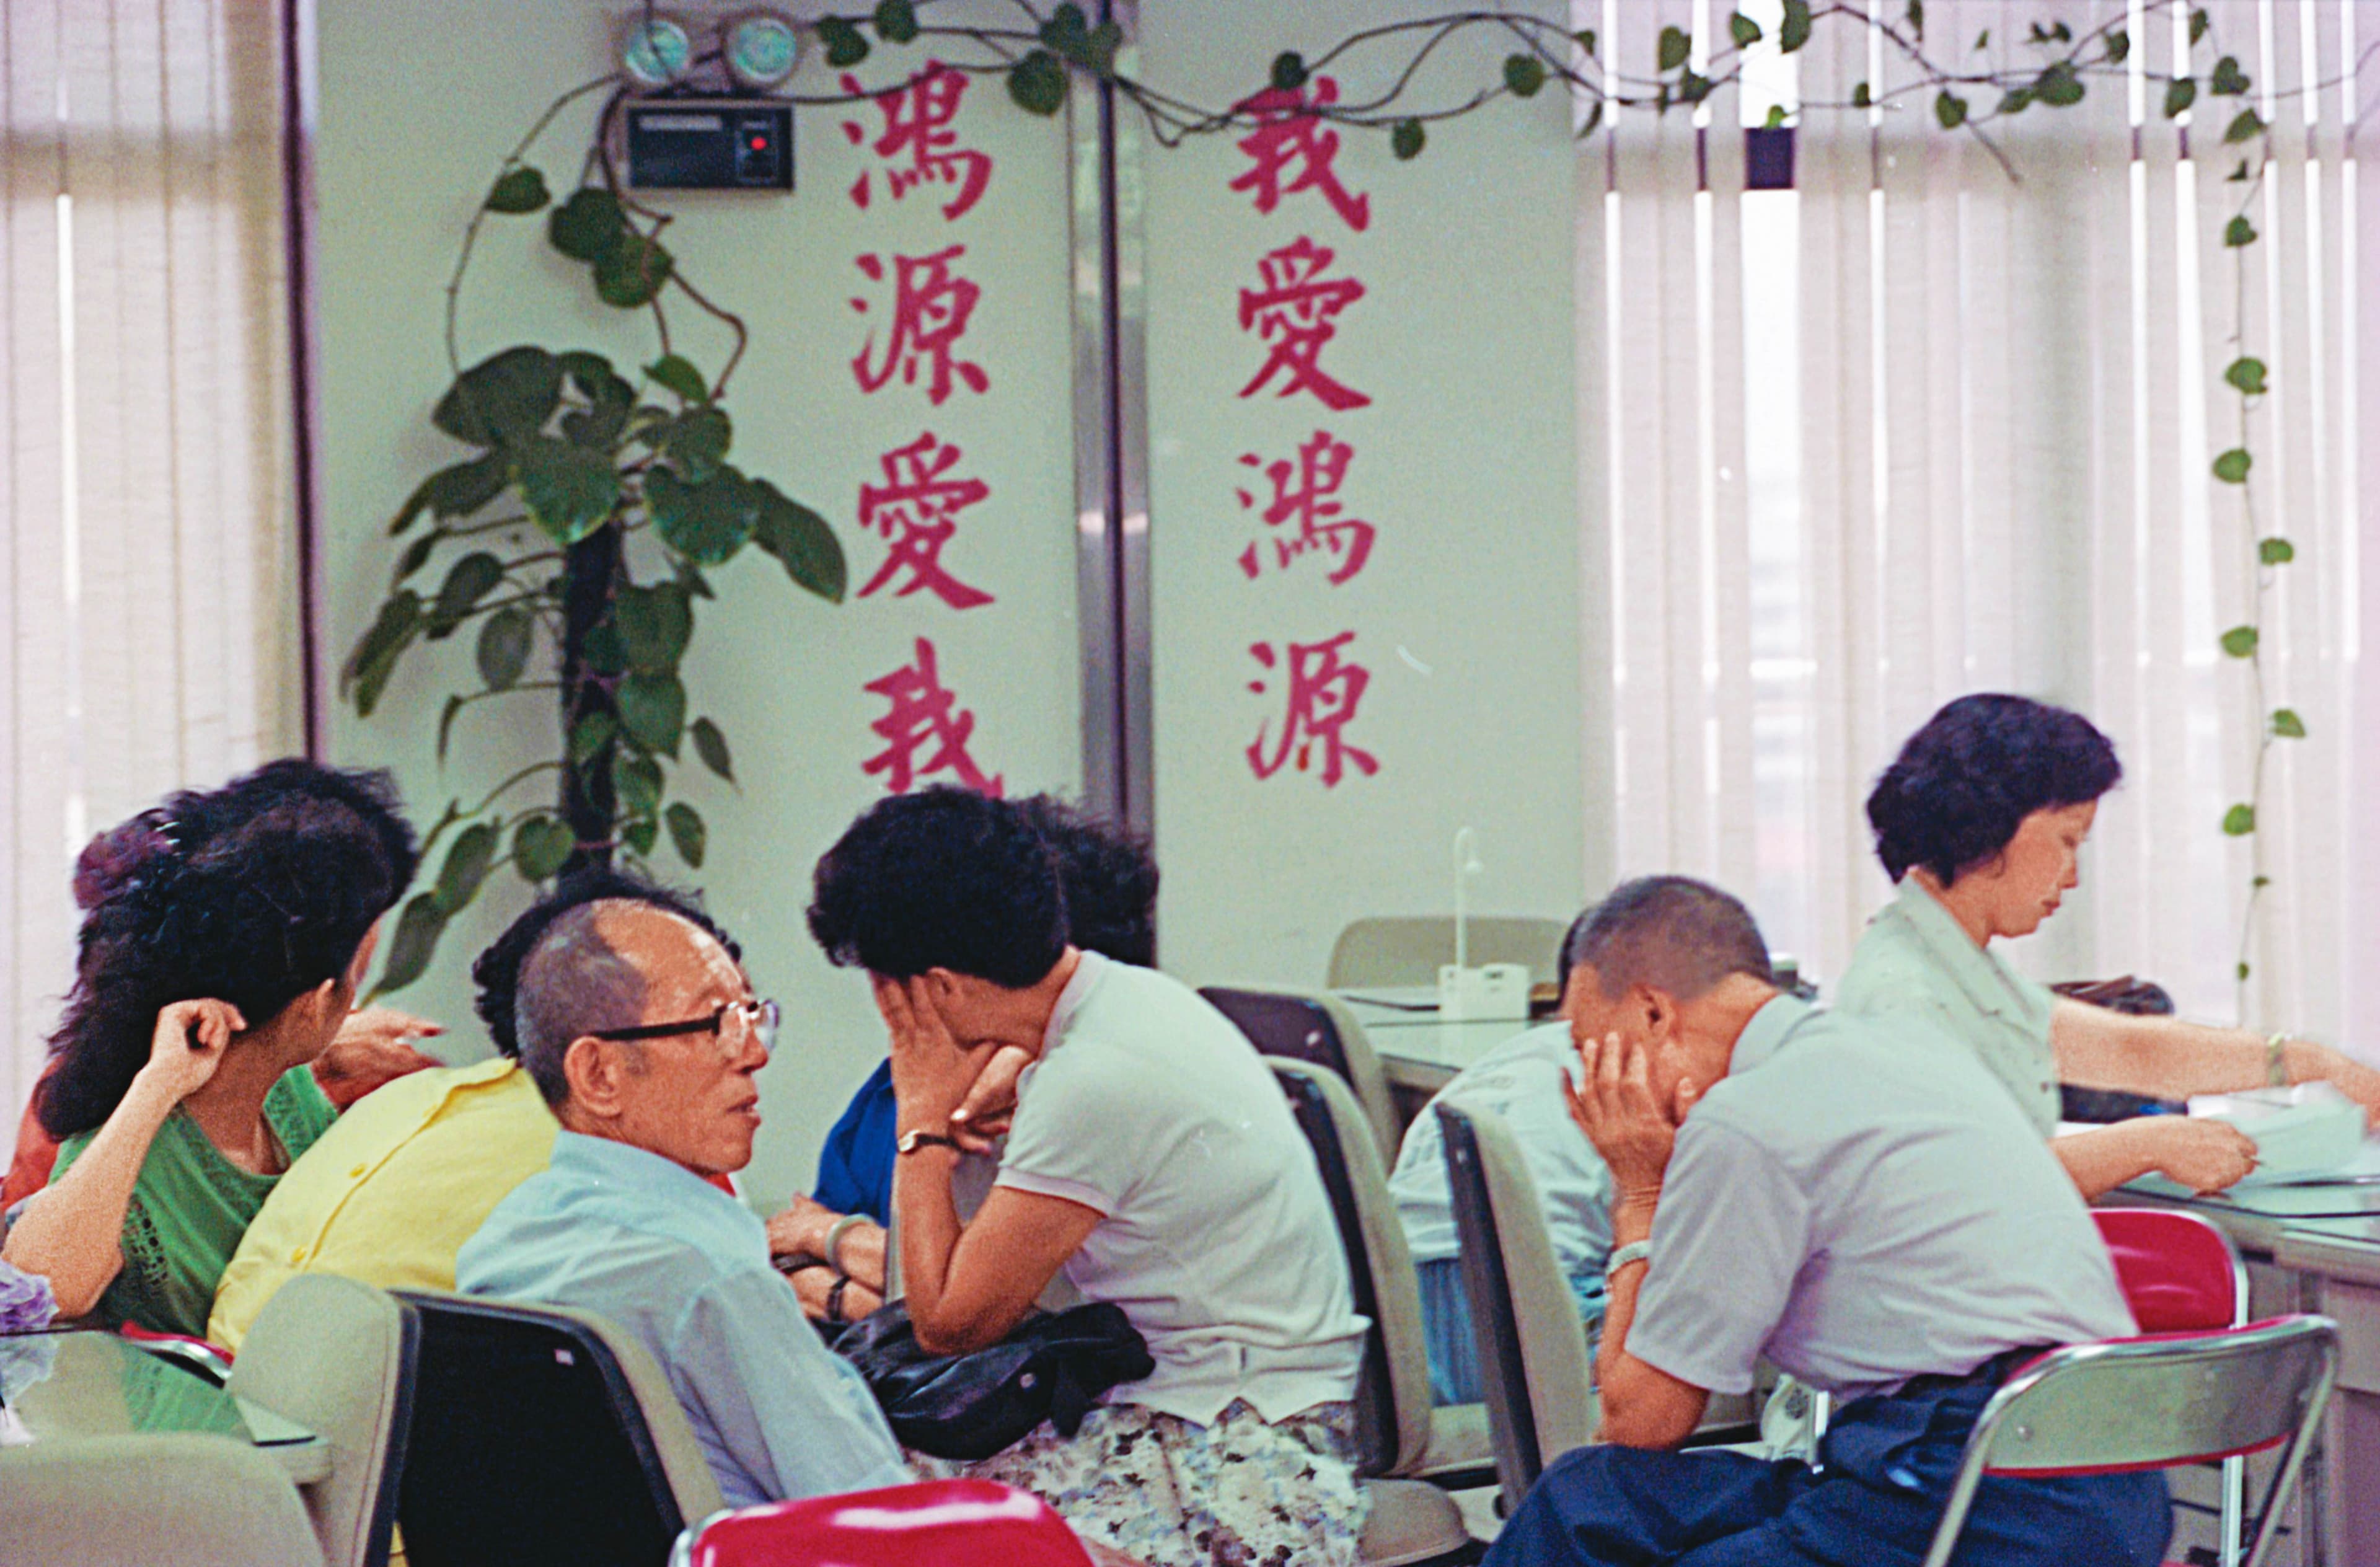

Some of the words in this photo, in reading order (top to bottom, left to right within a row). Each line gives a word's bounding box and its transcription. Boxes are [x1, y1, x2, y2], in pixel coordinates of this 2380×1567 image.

[840, 58, 1004, 800] 鴻源愛我
[1228, 75, 1380, 788] 我愛鴻源
